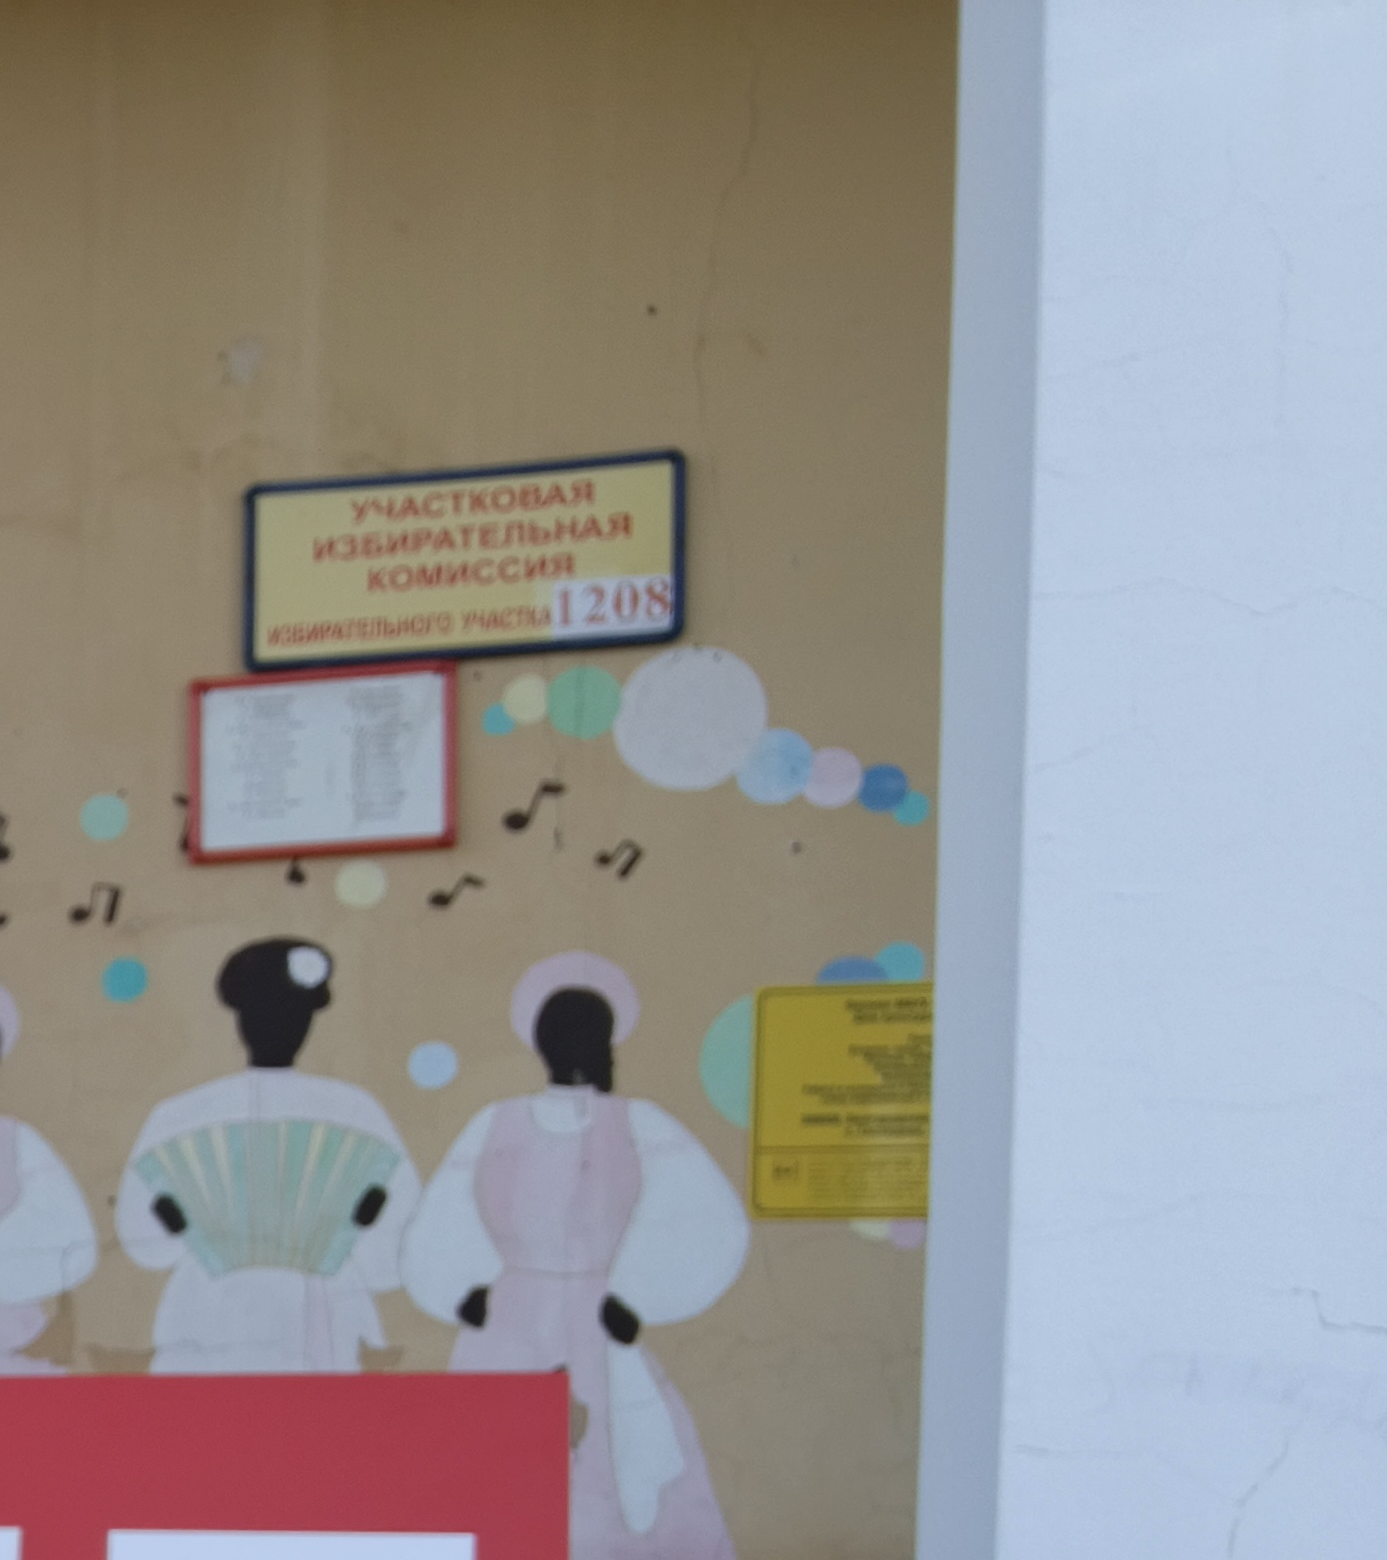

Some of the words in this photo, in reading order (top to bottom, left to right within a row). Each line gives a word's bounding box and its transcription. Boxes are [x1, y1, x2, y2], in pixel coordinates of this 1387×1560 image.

[352, 480, 595, 525] УЧАСТКОВАЯ
[312, 512, 632, 563] ИЗБИРАТЕЛЬНАЯ
[366, 552, 575, 593] КОМИССИЯ
[267, 612, 453, 647] ИЗБИРАТЕЛЬНОГО
[463, 605, 552, 632] УЧАСТКА
[557, 578, 670, 626] 1208
